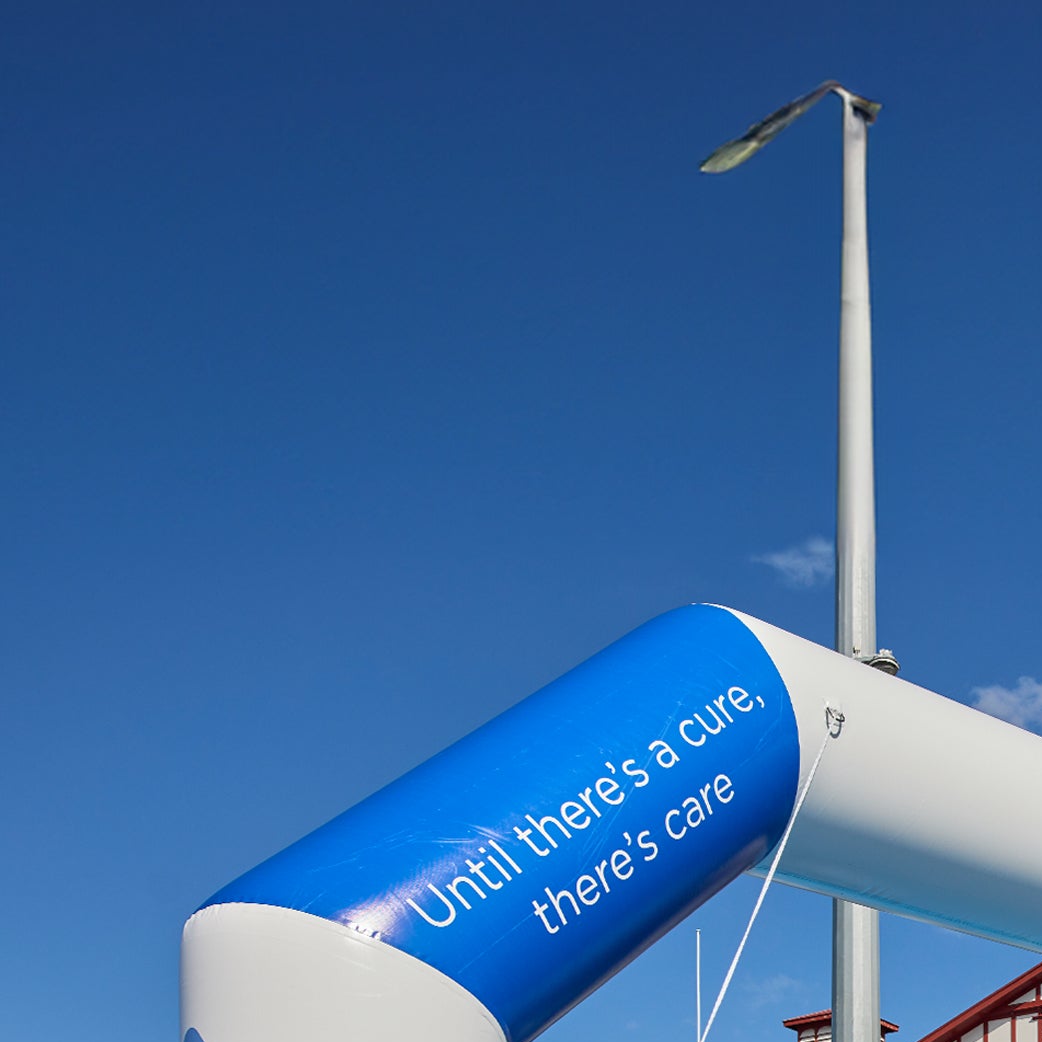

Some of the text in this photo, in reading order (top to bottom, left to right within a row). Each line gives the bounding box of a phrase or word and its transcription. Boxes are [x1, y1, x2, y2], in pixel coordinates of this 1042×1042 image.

[405, 685, 765, 928] Until there's a cure,
[531, 773, 735, 935] there's care
